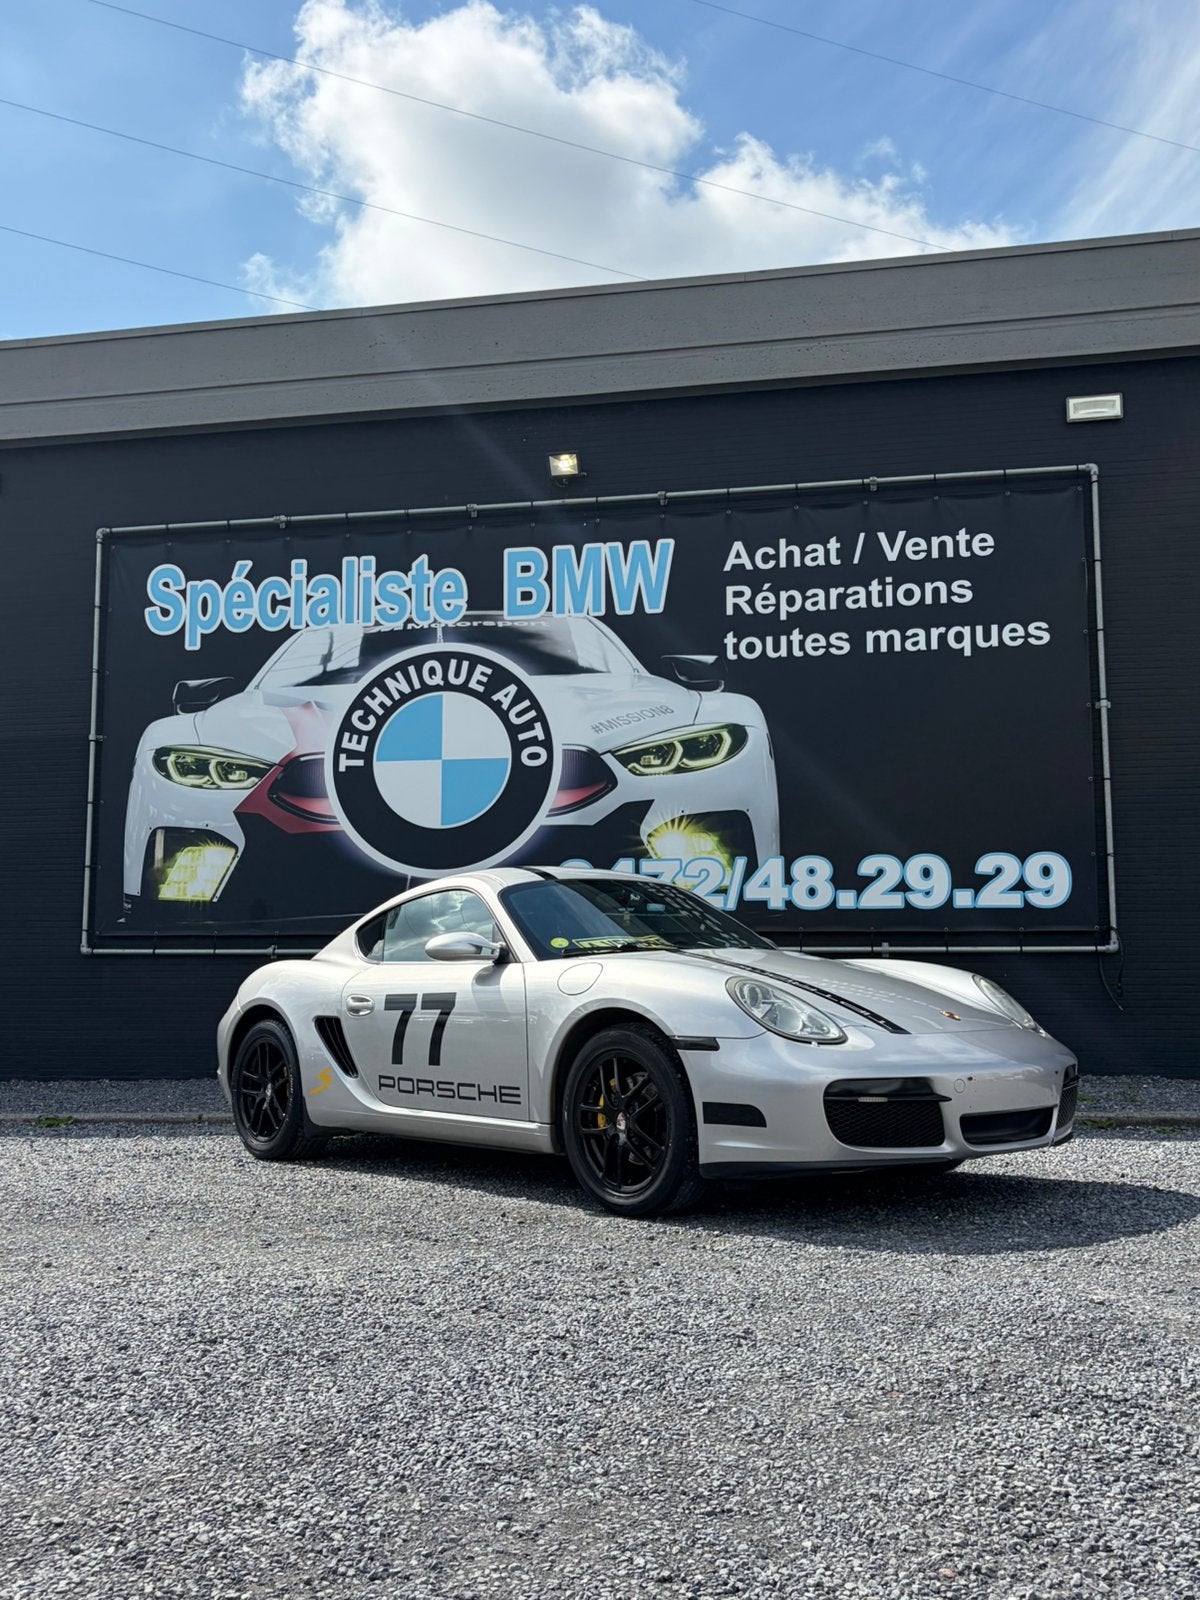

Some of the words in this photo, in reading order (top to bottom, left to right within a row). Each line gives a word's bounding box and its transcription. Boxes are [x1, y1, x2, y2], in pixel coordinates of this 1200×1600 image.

[723, 536, 841, 571] Achat
[852, 532, 866, 565] /
[877, 527, 995, 562] Vente
[144, 553, 468, 650] Spécialiste
[503, 538, 675, 620] BMW
[725, 576, 974, 621] Réparations
[724, 627, 851, 660] toutes
[866, 621, 1051, 656] marques
[338, 658, 493, 772] TECHNIQUE
[491, 683, 548, 767] AUTO
[591, 705, 675, 735] #MISSION8
[560, 851, 1073, 911] 72/48.29.29
[384, 992, 457, 1066] 77
[378, 1074, 521, 1105] PORSCHE
